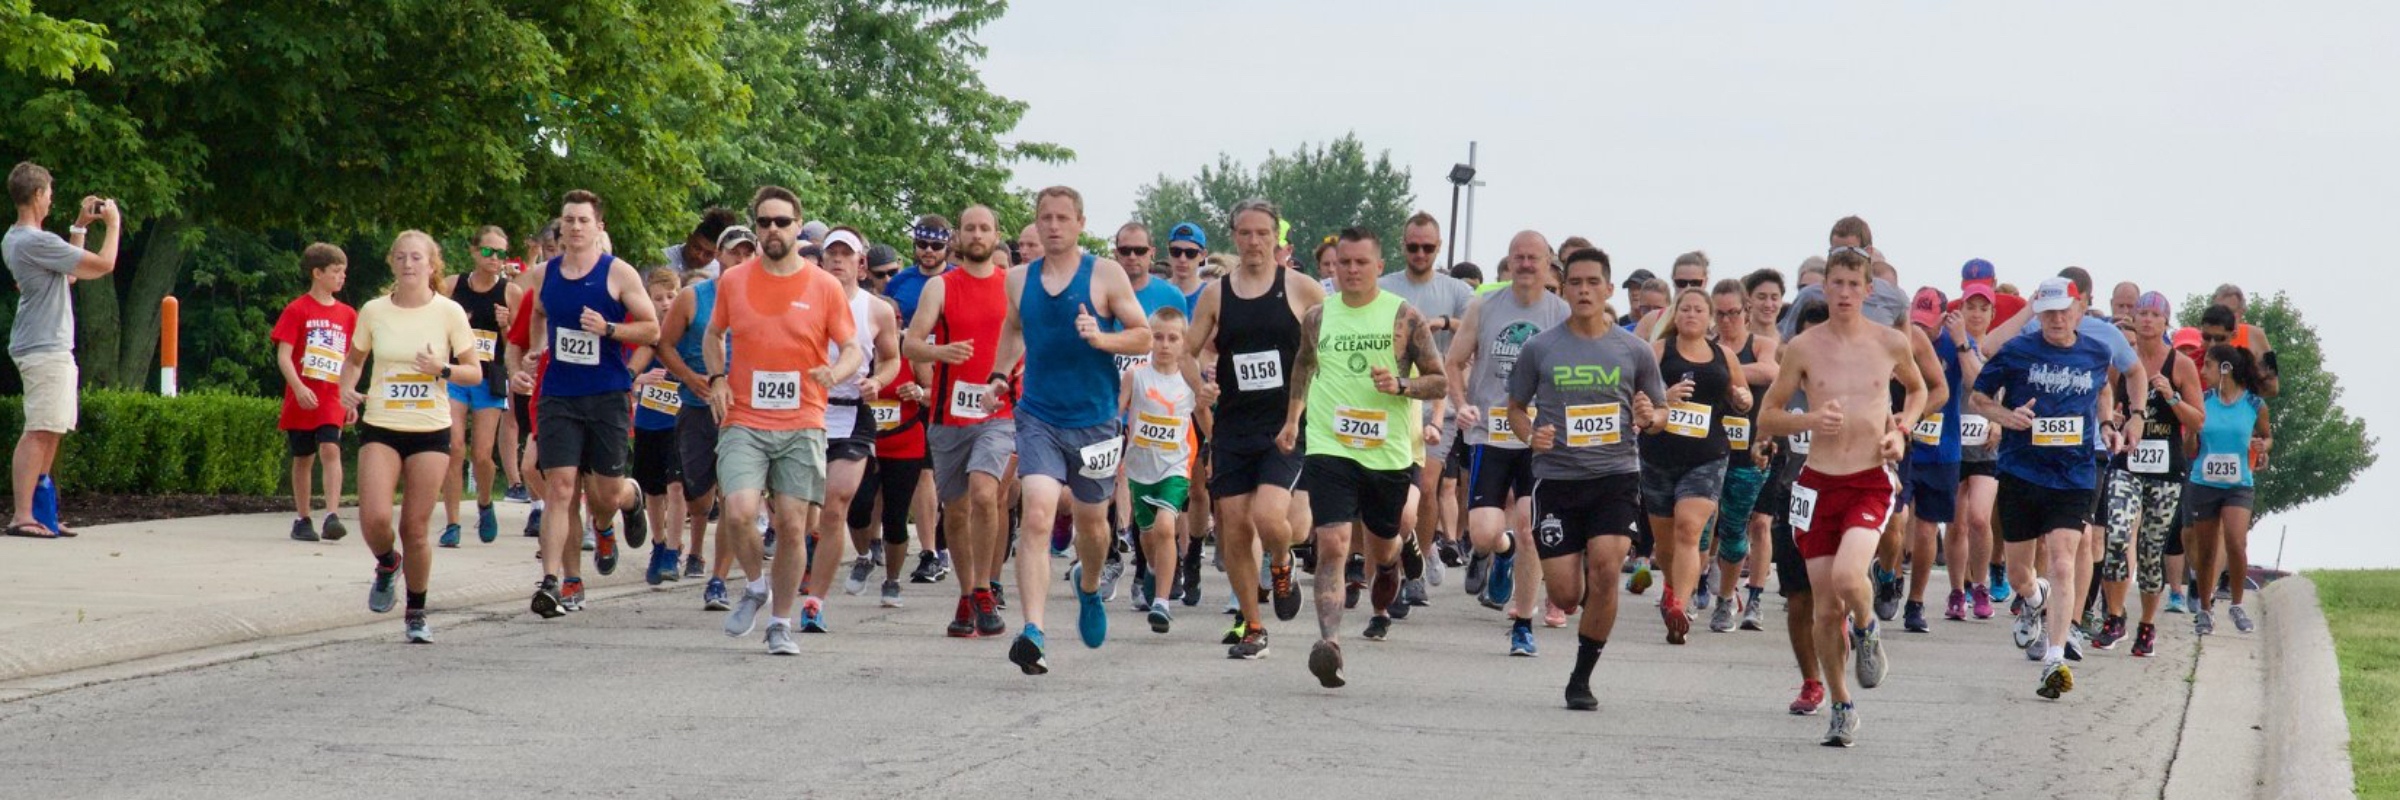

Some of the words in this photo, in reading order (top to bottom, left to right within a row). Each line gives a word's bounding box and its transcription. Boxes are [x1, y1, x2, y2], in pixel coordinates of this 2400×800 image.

[560, 337, 594, 356] 9221
[1334, 340, 1392, 352] CLEANUP
[309, 355, 338, 372] 3641
[1240, 360, 1277, 381] 9158
[390, 384, 429, 398] 3702
[648, 386, 679, 405] 3295
[758, 382, 795, 399] 9249
[1574, 416, 1613, 433] 4025
[1669, 409, 1704, 426] 3710
[2039, 419, 2076, 433] 3681
[1140, 424, 1175, 440] 4024
[1340, 418, 1379, 437] 3704
[1962, 422, 1984, 437] 227
[2132, 448, 2164, 464] 9237
[2207, 461, 2237, 475] 9235
[1790, 495, 1809, 519] 230
